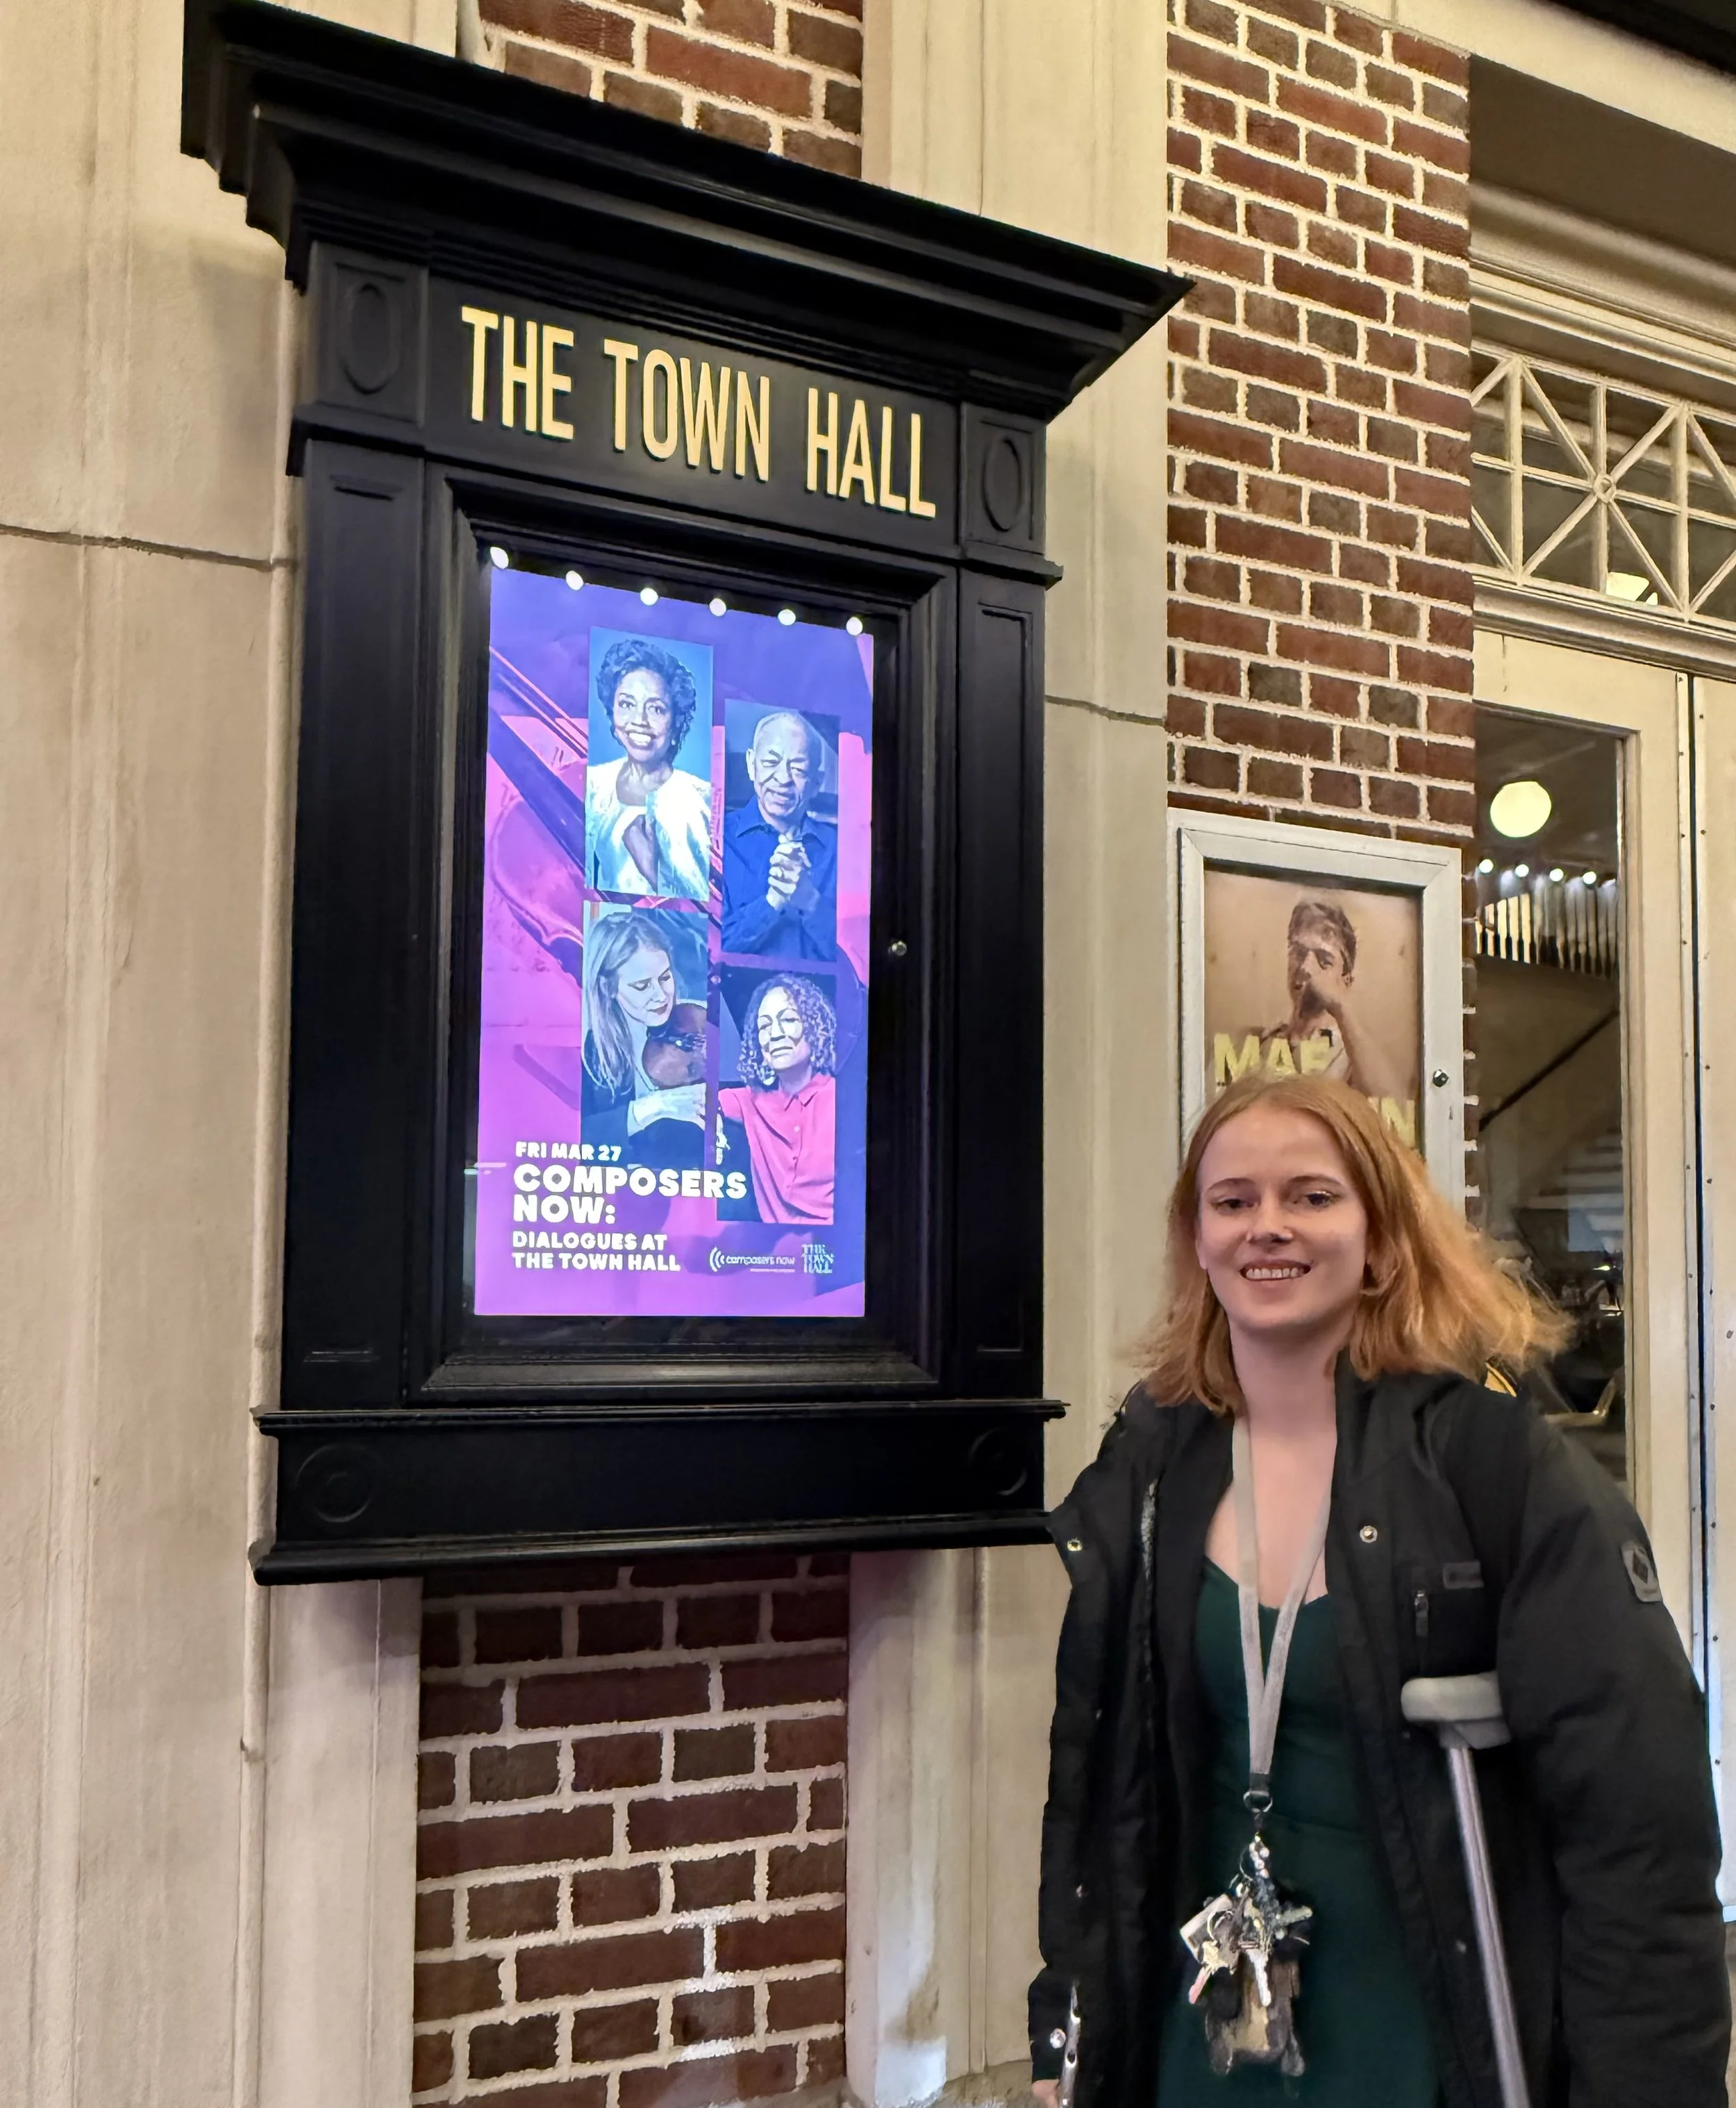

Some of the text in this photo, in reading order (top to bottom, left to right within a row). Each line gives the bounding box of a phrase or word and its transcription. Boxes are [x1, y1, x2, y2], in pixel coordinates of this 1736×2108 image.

[462, 306, 937, 519] THE TOWN HALL
[515, 1141, 621, 1161] FRI MAR 27
[513, 1163, 747, 1199] COMPOSERS
[513, 1194, 616, 1224] NOW:
[512, 1230, 668, 1251] DIALOGUES AT
[511, 1252, 681, 1272] THE TOWN HALL
